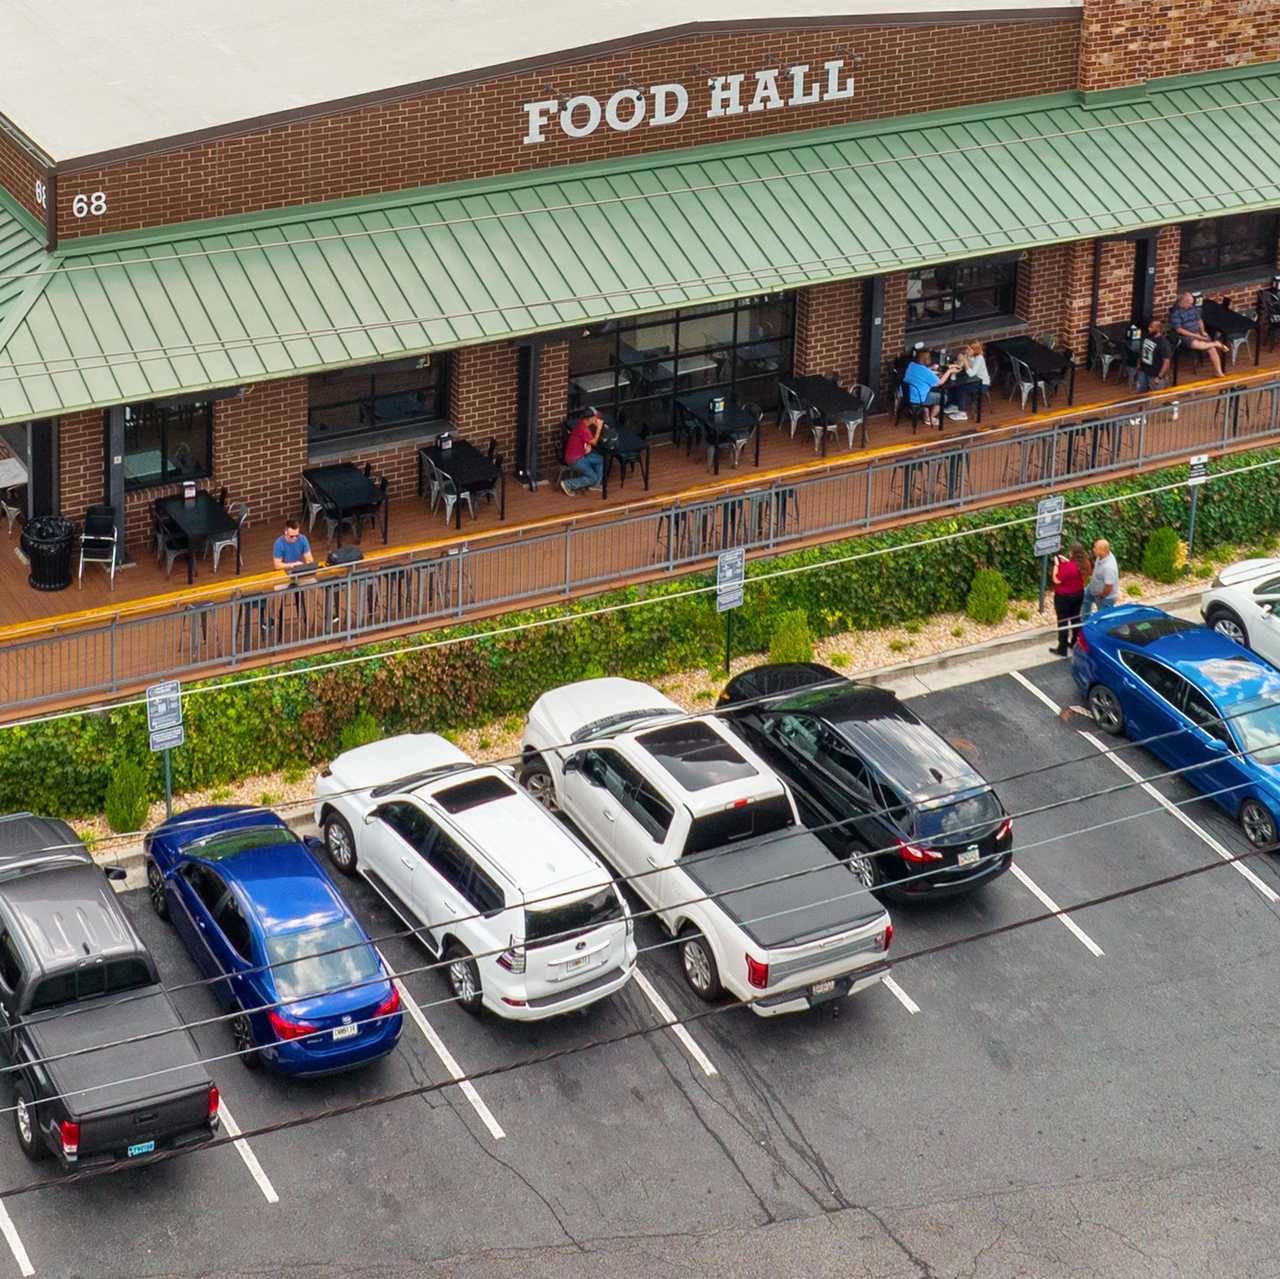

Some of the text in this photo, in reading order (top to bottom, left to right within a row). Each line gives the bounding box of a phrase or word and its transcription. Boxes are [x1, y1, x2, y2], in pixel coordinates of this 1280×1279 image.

[523, 60, 854, 145] FOOD HALL
[72, 192, 107, 218] 68
